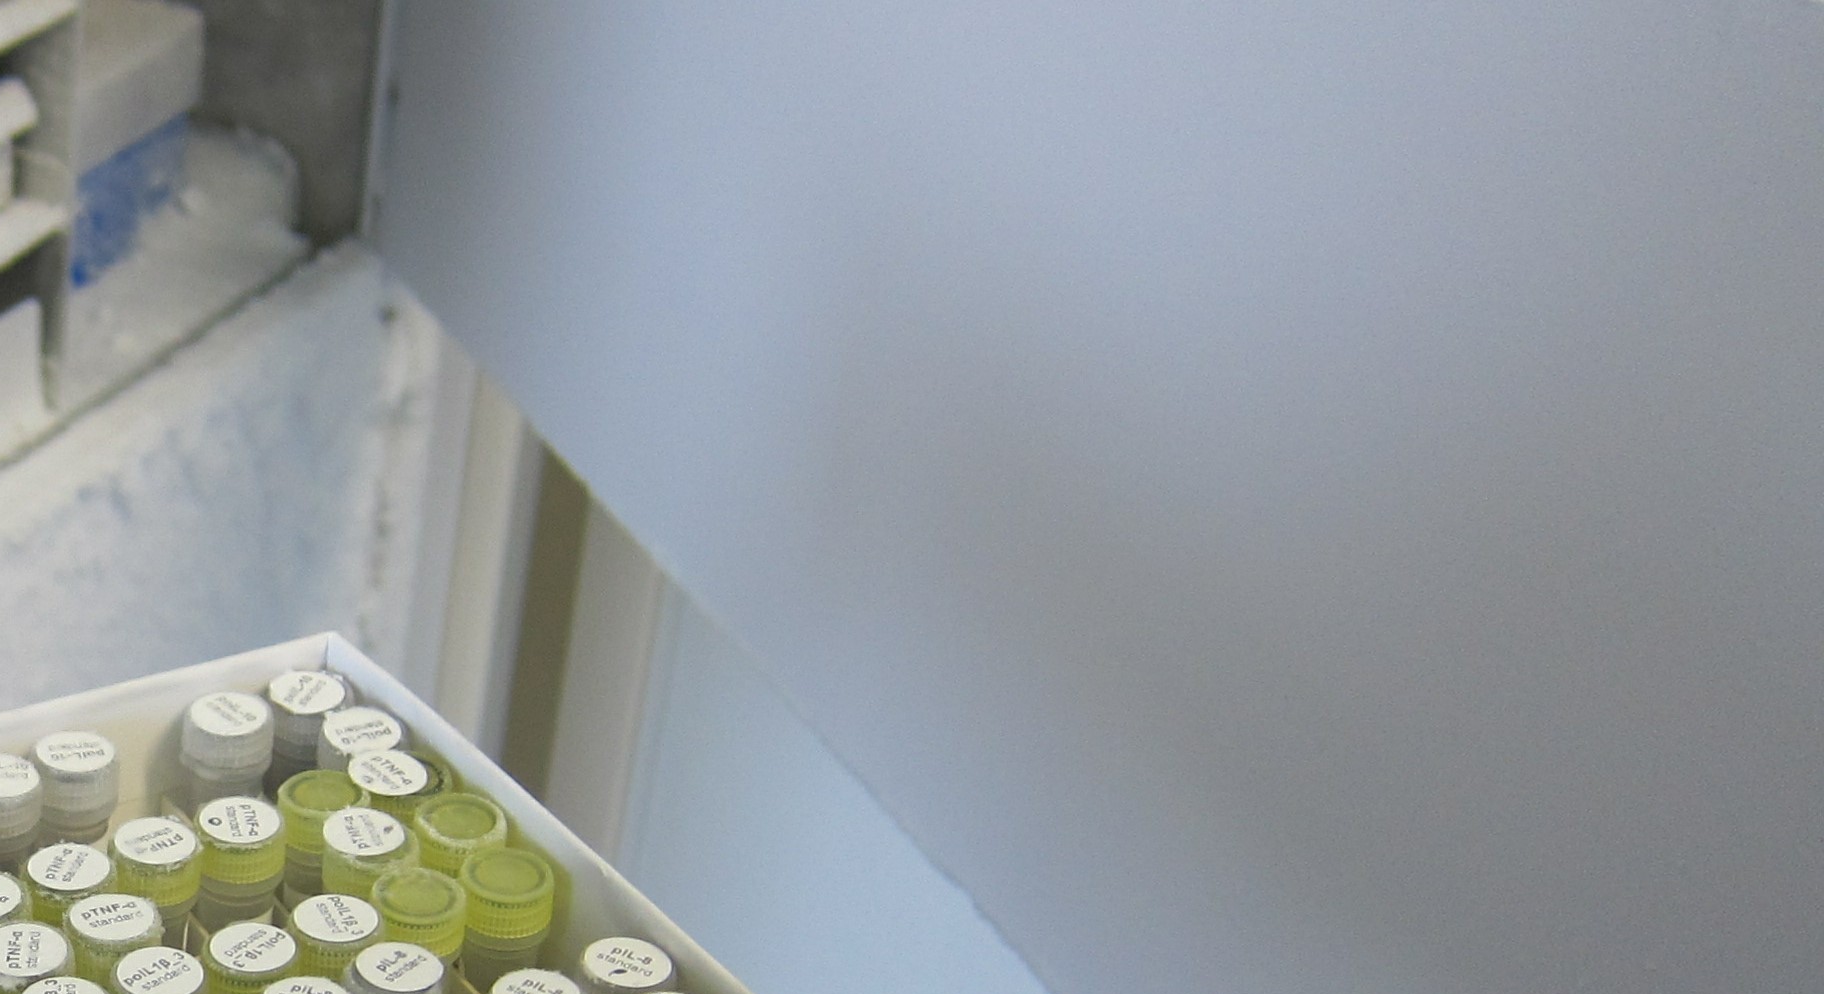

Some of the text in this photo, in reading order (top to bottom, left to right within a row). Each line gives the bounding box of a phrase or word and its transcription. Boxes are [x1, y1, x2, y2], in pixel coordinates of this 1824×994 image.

[89, 911, 144, 928] standard
[224, 928, 270, 957] standard
[376, 951, 407, 973] pIL-8
[385, 954, 428, 982] standard
[596, 952, 654, 978] standard
[610, 946, 653, 966] pIL-8
[141, 963, 192, 991] standard
